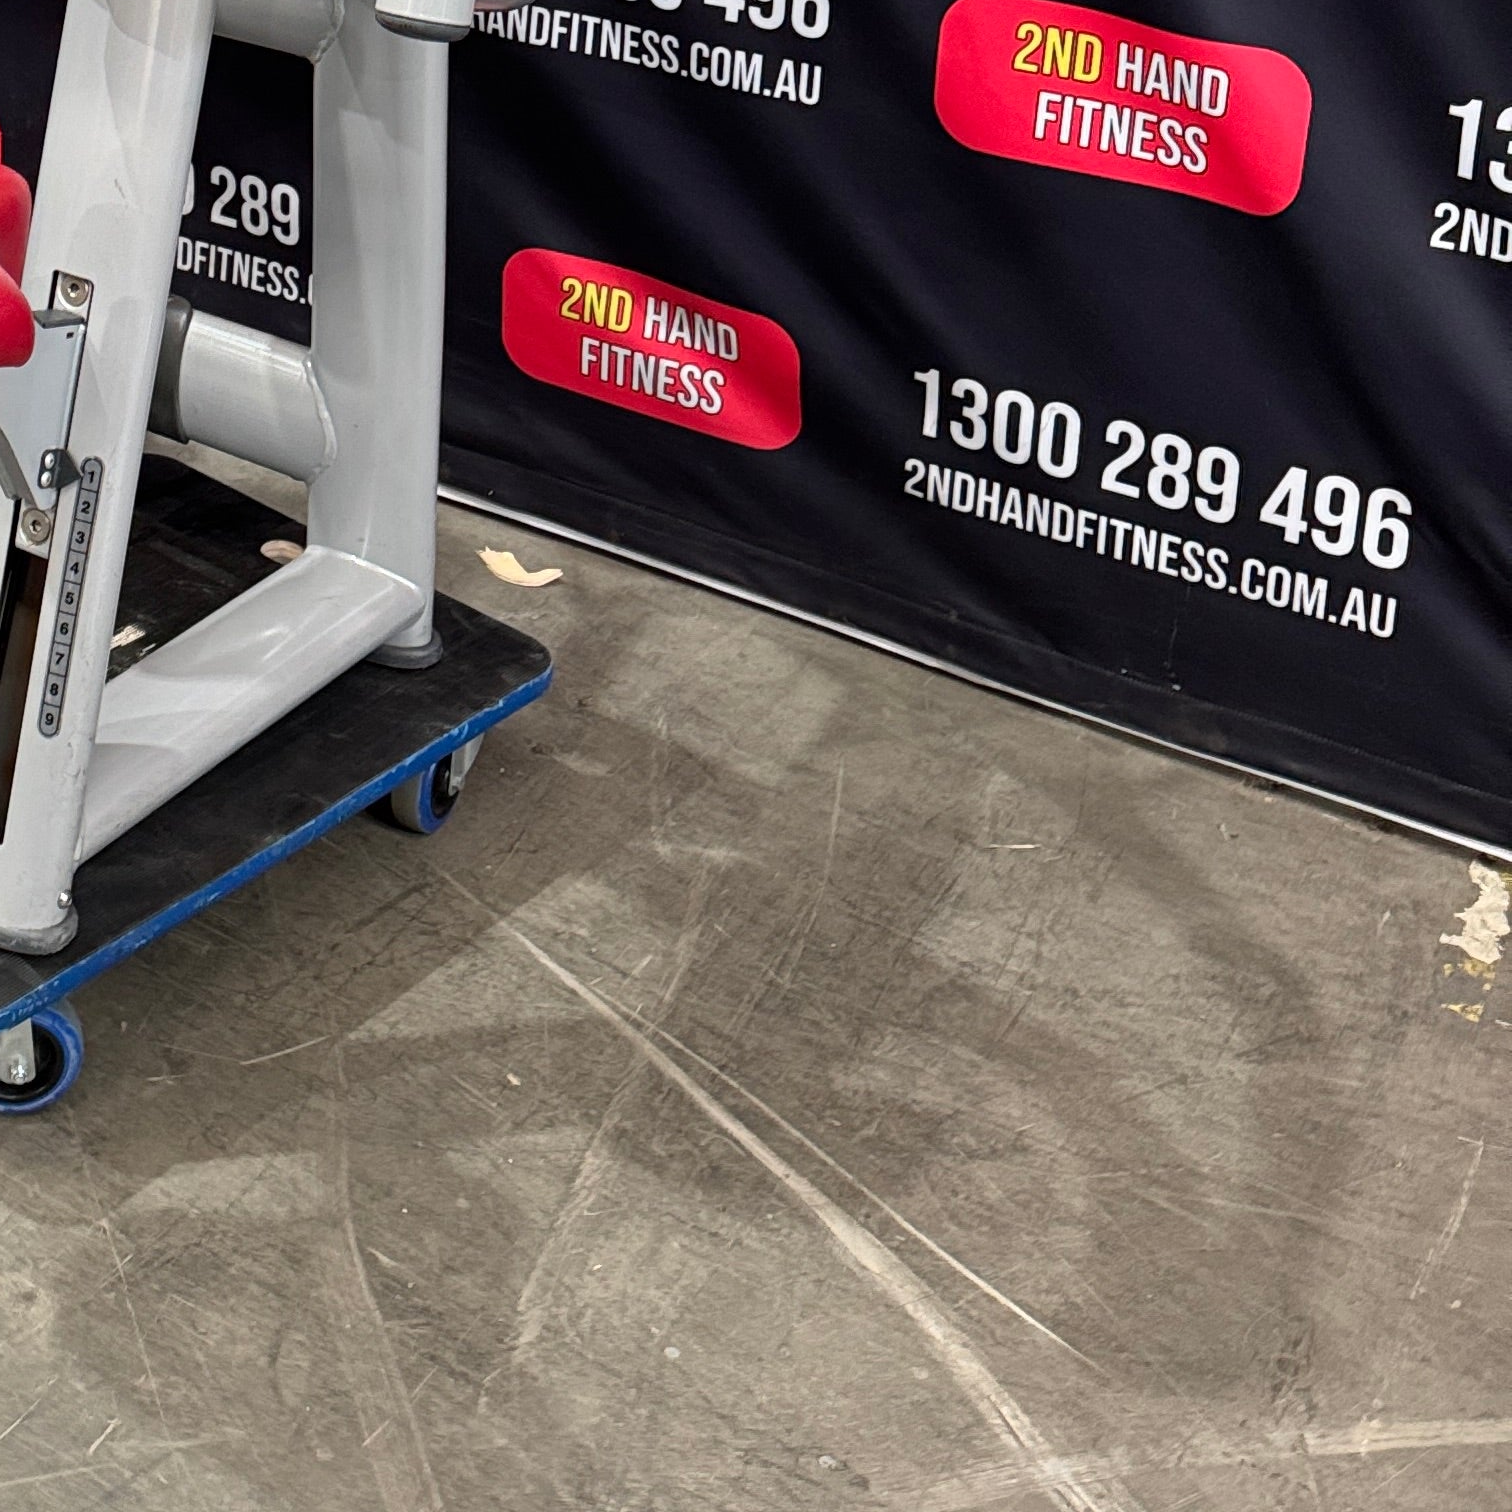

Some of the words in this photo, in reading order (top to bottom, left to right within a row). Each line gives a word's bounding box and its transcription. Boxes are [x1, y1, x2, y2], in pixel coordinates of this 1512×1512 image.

[1012, 22, 1103, 83] 2ND
[1116, 42, 1230, 117] HAND
[1034, 91, 1209, 174] FITNESS
[210, 166, 300, 246] 289
[560, 277, 633, 334] 2ND
[643, 296, 738, 362] HAND
[581, 337, 724, 415] FITNESS
[914, 368, 1081, 479] 1300
[1100, 419, 1241, 524] 289
[1260, 466, 1412, 570] 496
[88, 470, 95, 484] 1
[80, 501, 91, 515] 2
[75, 531, 86, 544] 3
[904, 458, 1398, 639] 2NDHANDFITNESS.COM.AU
[70, 561, 80, 575] 4
[64, 592, 74, 605] 5
[59, 622, 69, 635] 6
[55, 653, 65, 666] 7
[49, 683, 59, 696] 8
[44, 713, 54, 726] 9
